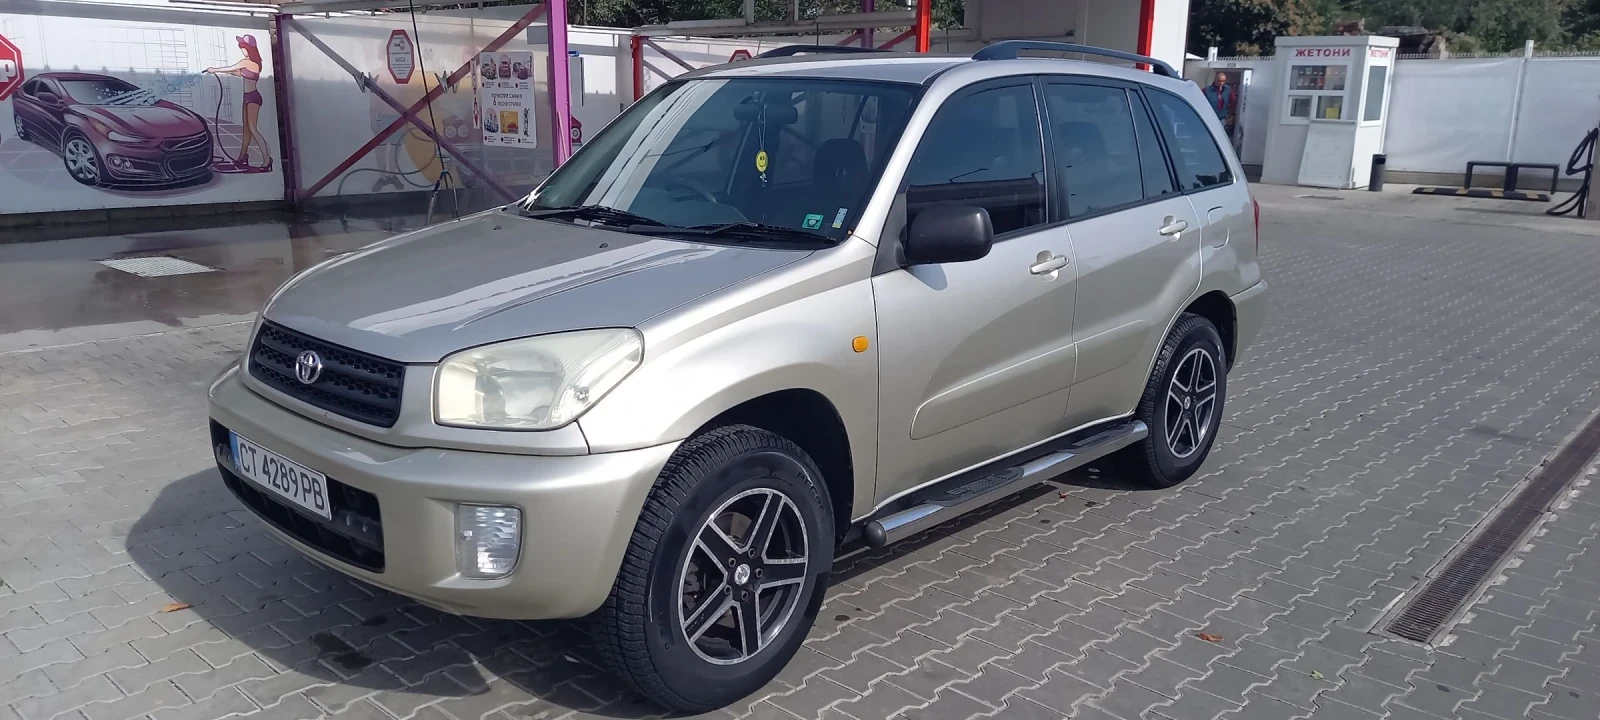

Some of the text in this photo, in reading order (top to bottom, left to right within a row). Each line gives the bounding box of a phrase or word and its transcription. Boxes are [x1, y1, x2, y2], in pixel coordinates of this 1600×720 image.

[1295, 48, 1350, 57] ЖЕТОНИ
[240, 443, 325, 511] CT 4289 PB
